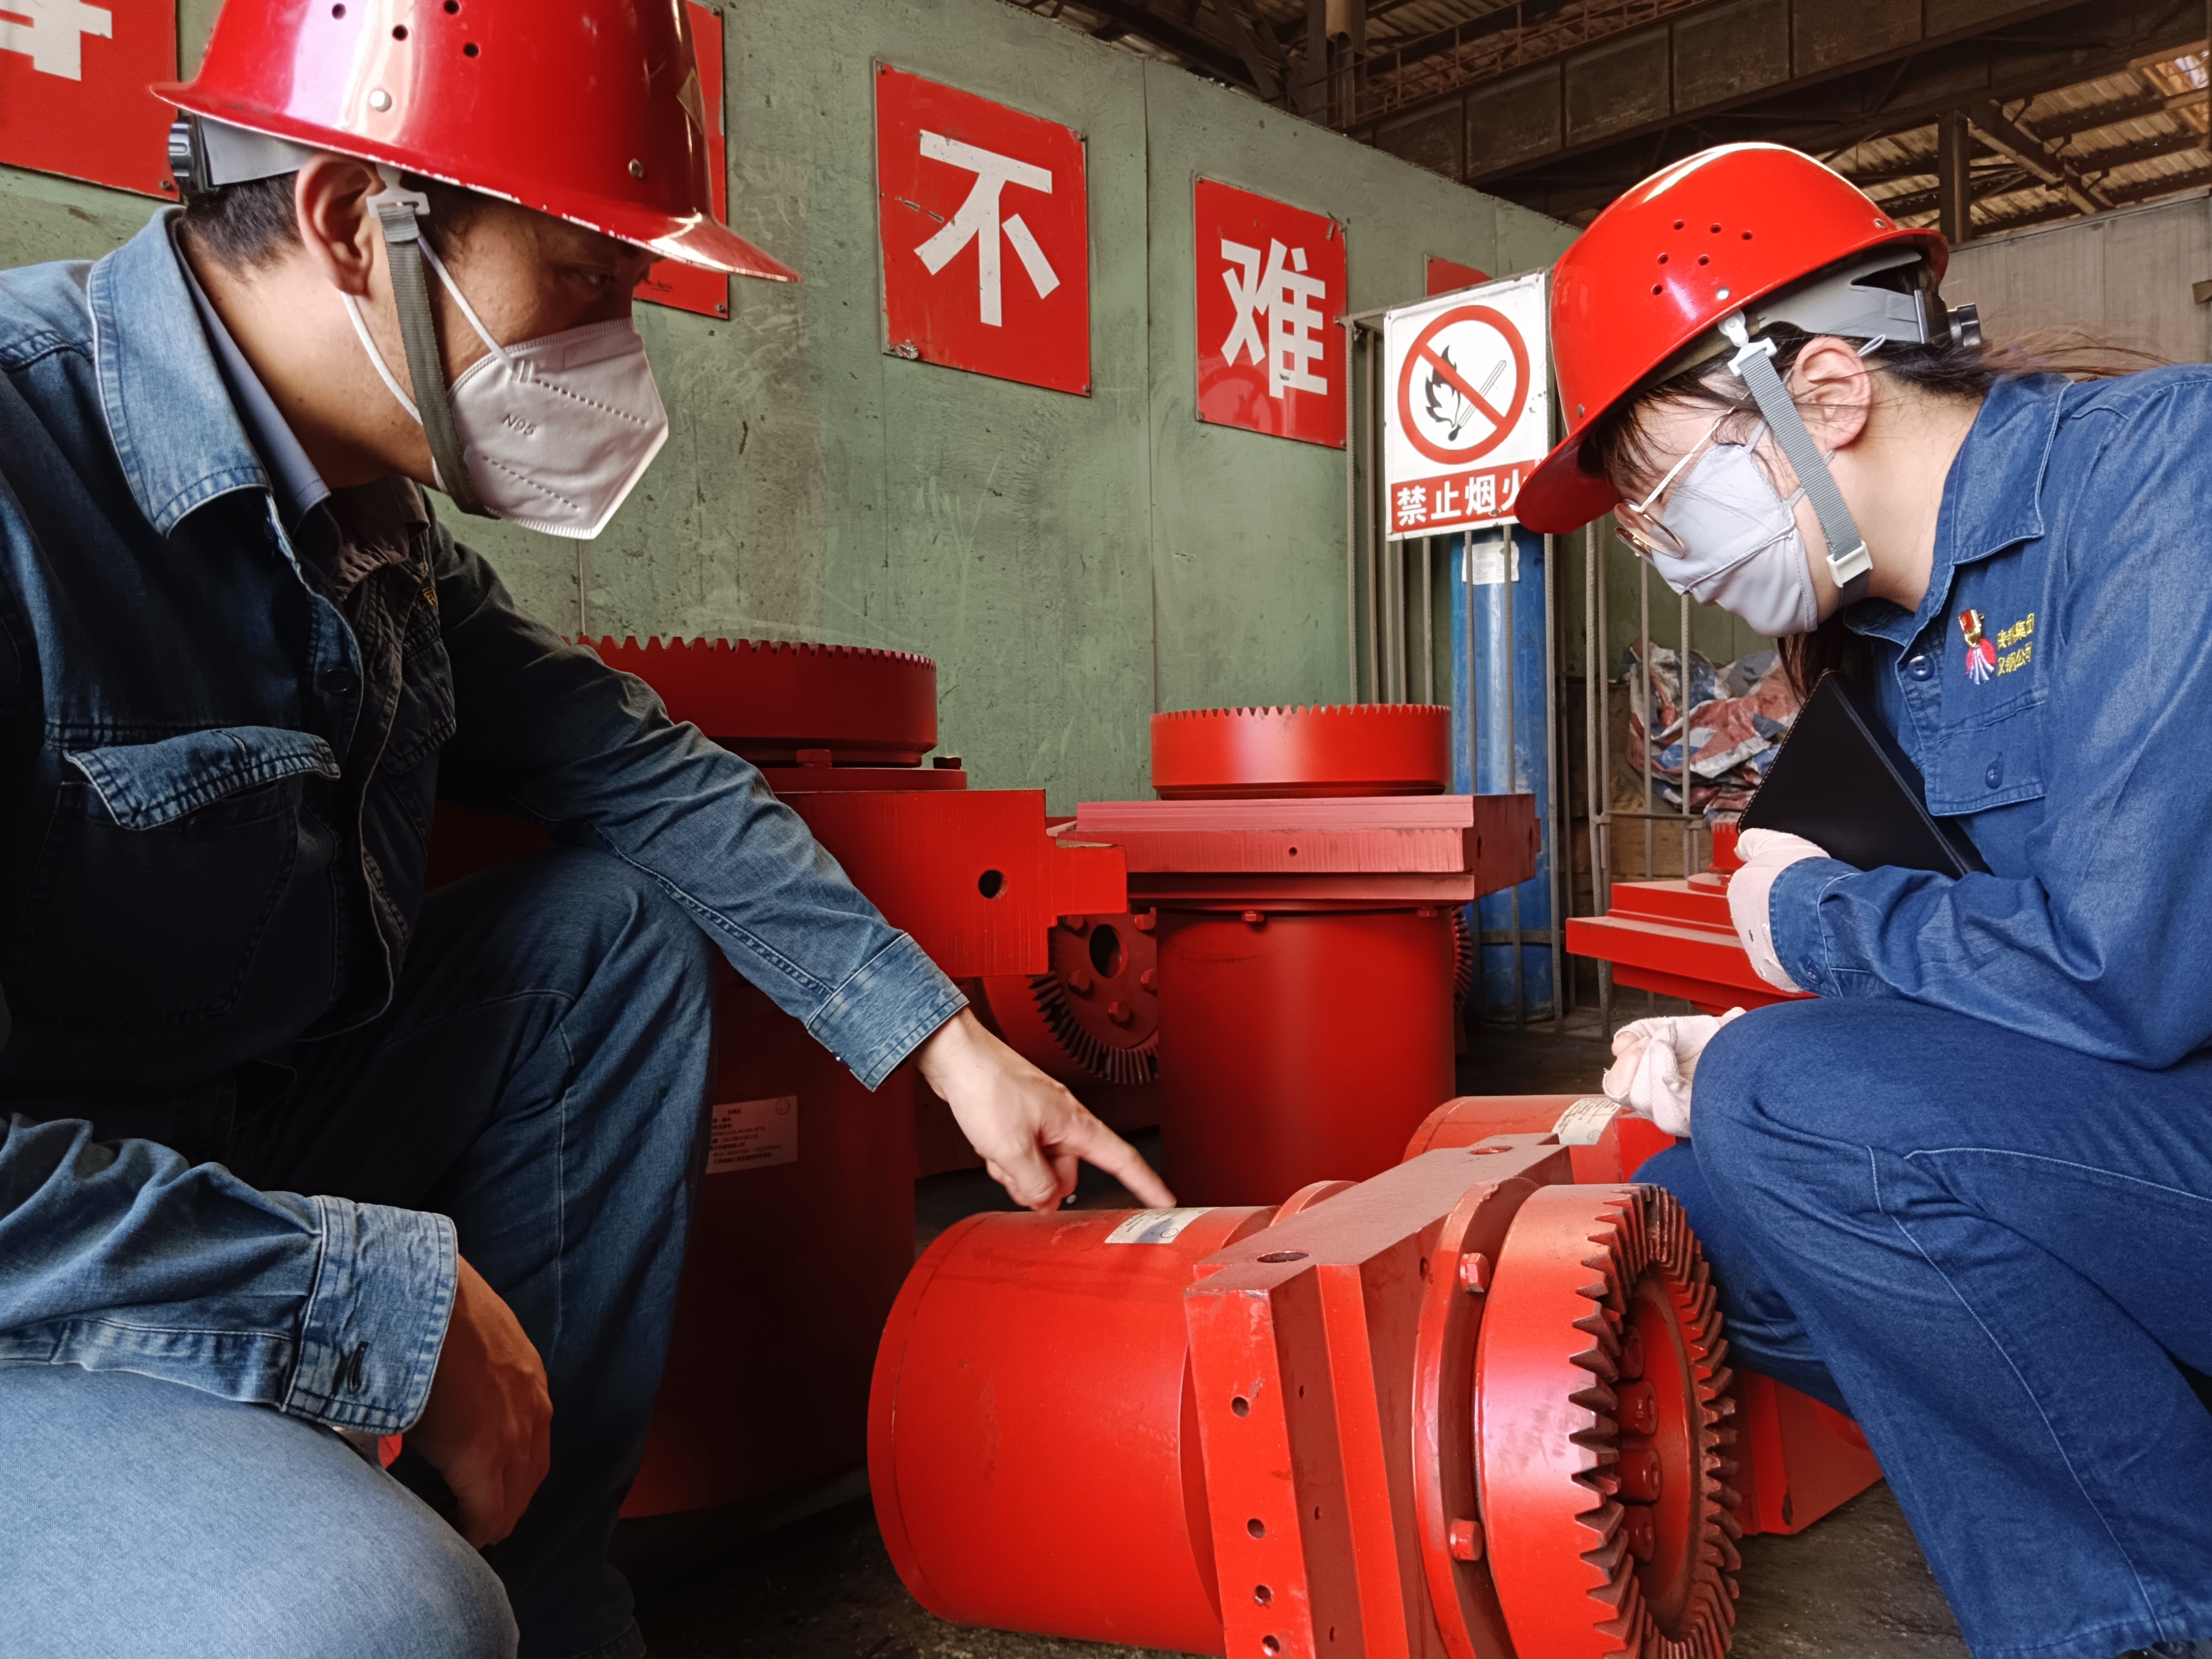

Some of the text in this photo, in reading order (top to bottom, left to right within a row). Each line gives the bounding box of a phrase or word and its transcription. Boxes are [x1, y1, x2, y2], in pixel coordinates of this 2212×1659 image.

[914, 130, 1060, 327] 不
[1220, 238, 1328, 399] 难
[502, 414, 537, 435] N95
[1397, 468, 1529, 526] 禁止烟火
